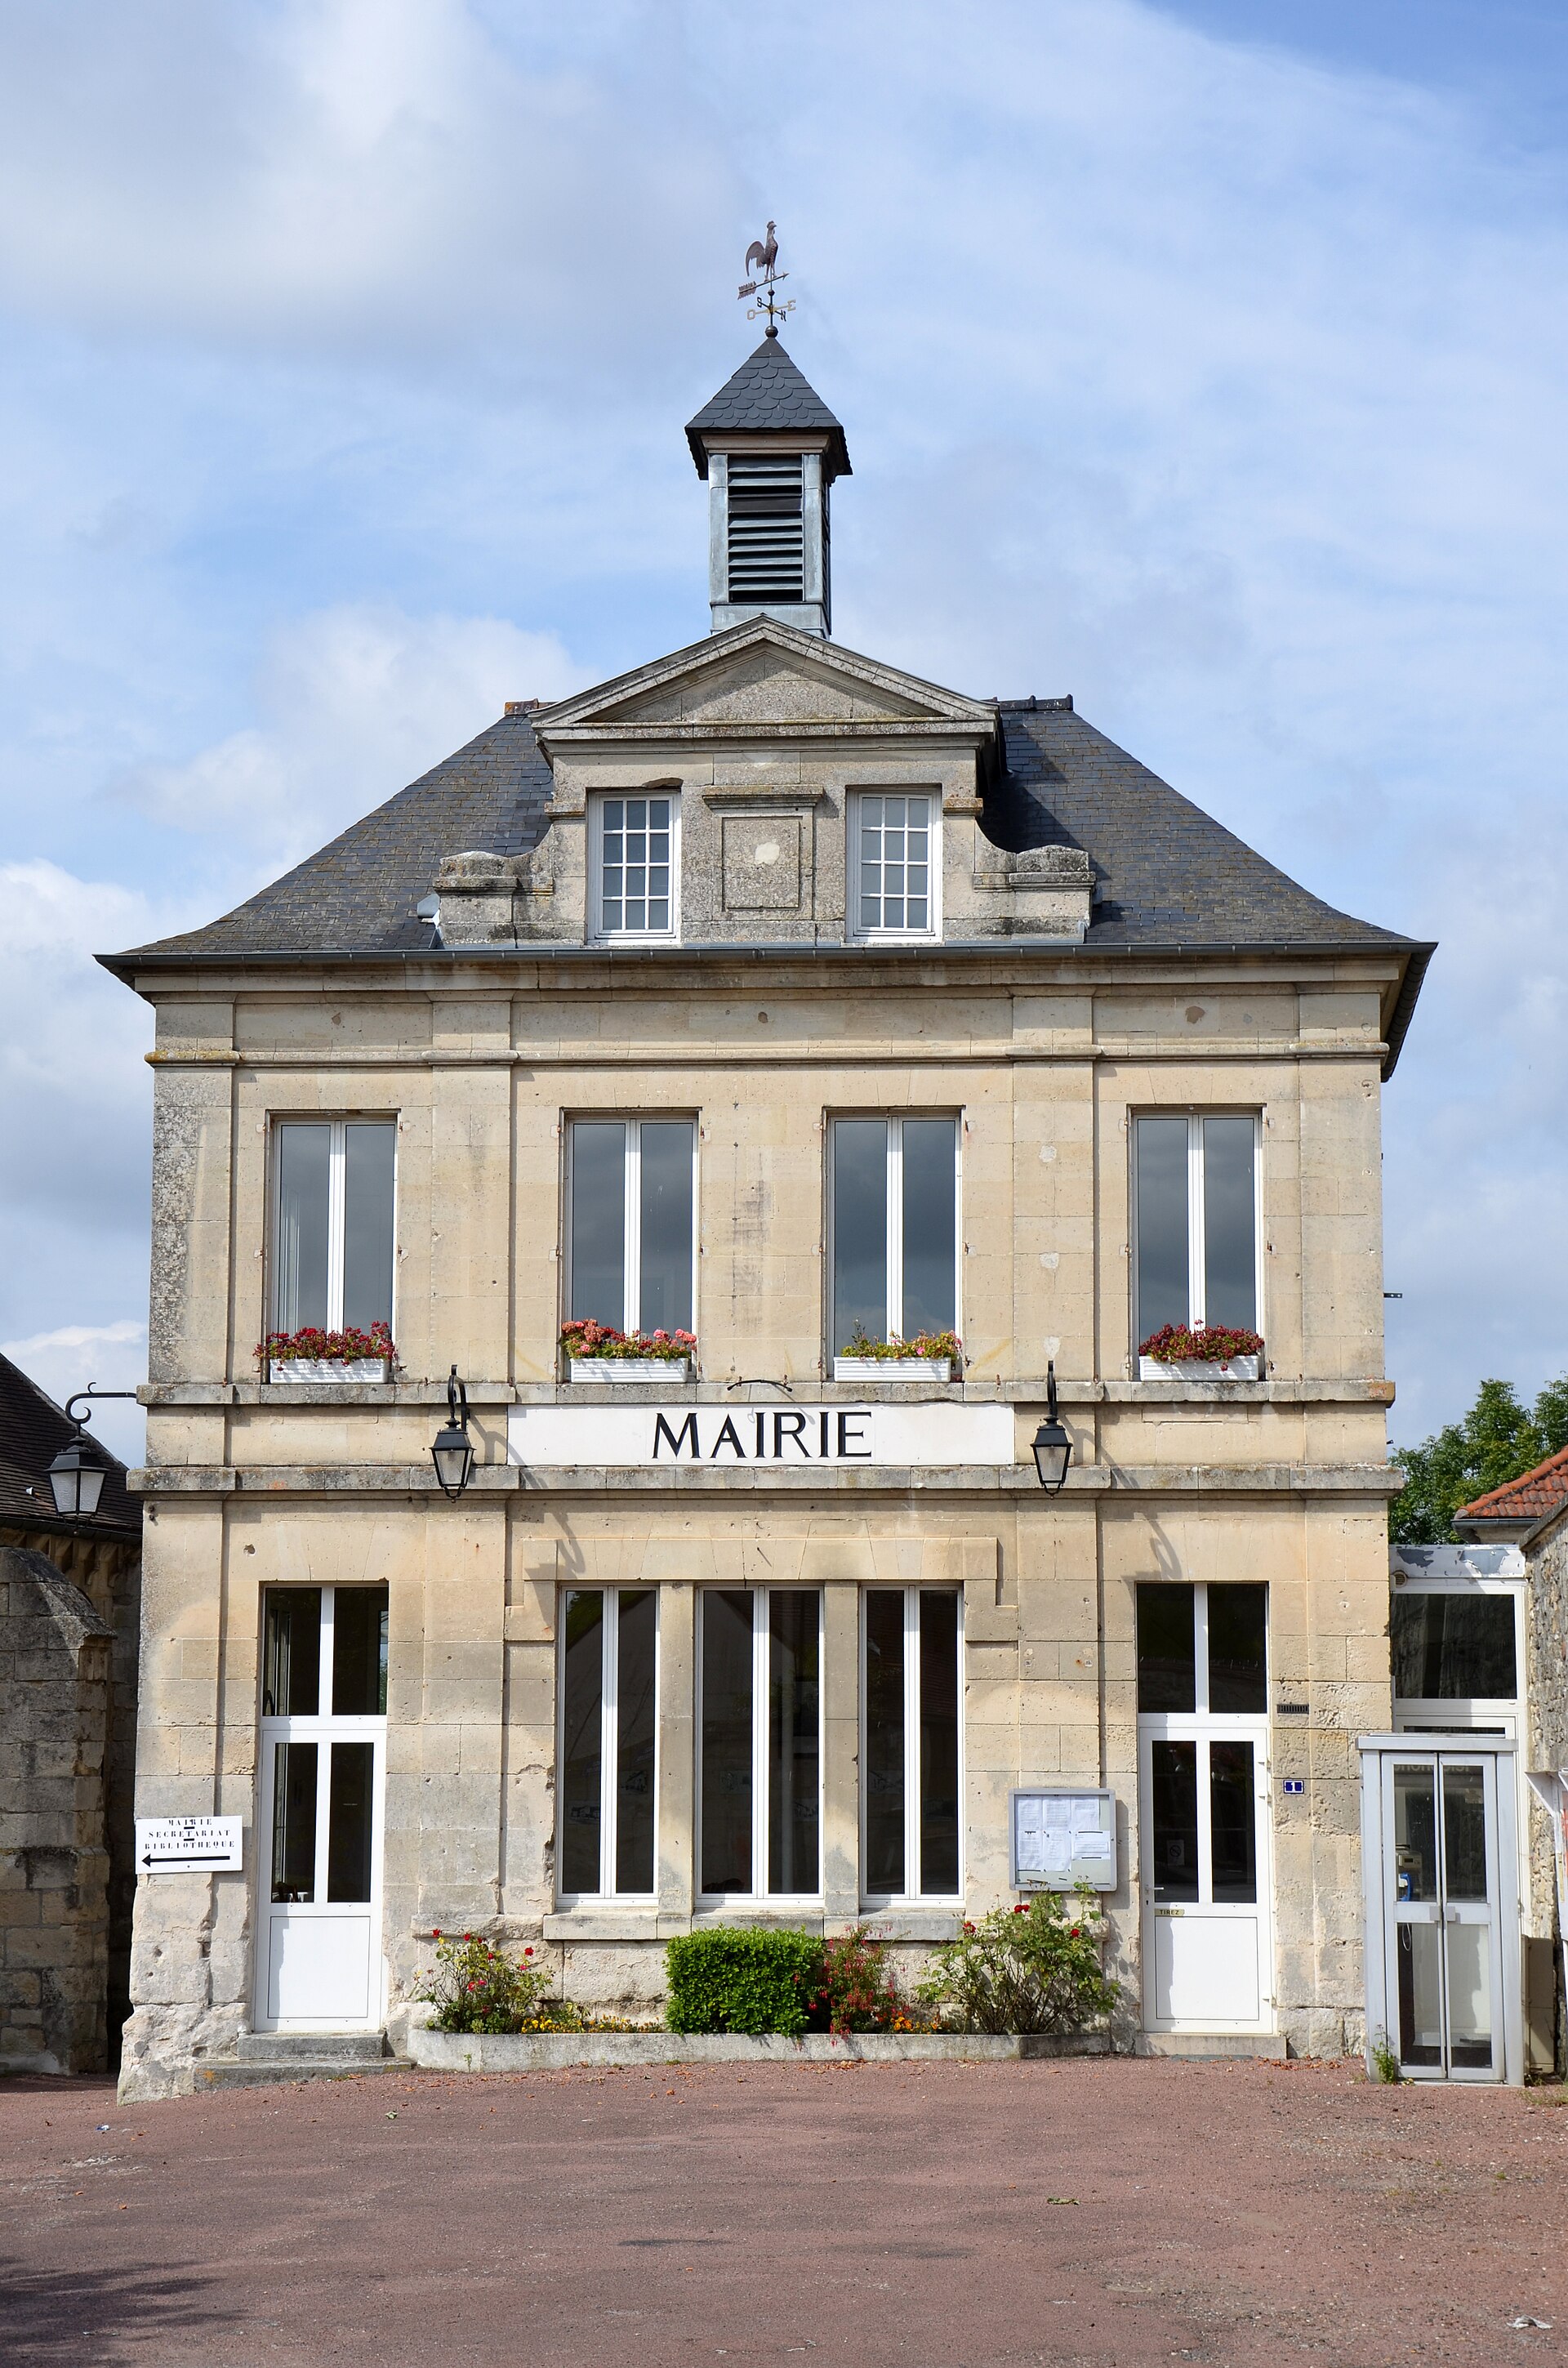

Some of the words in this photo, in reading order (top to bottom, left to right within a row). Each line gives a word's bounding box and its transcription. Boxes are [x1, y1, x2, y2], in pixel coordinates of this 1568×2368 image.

[787, 299, 796, 311] E
[746, 309, 755, 320] O
[652, 1411, 872, 1460] MAIRIE
[168, 1818, 212, 1826] MAIRIE
[149, 1830, 230, 1838] SECRETARIAT
[145, 1840, 234, 1849] BIBLIOTHEQUE
